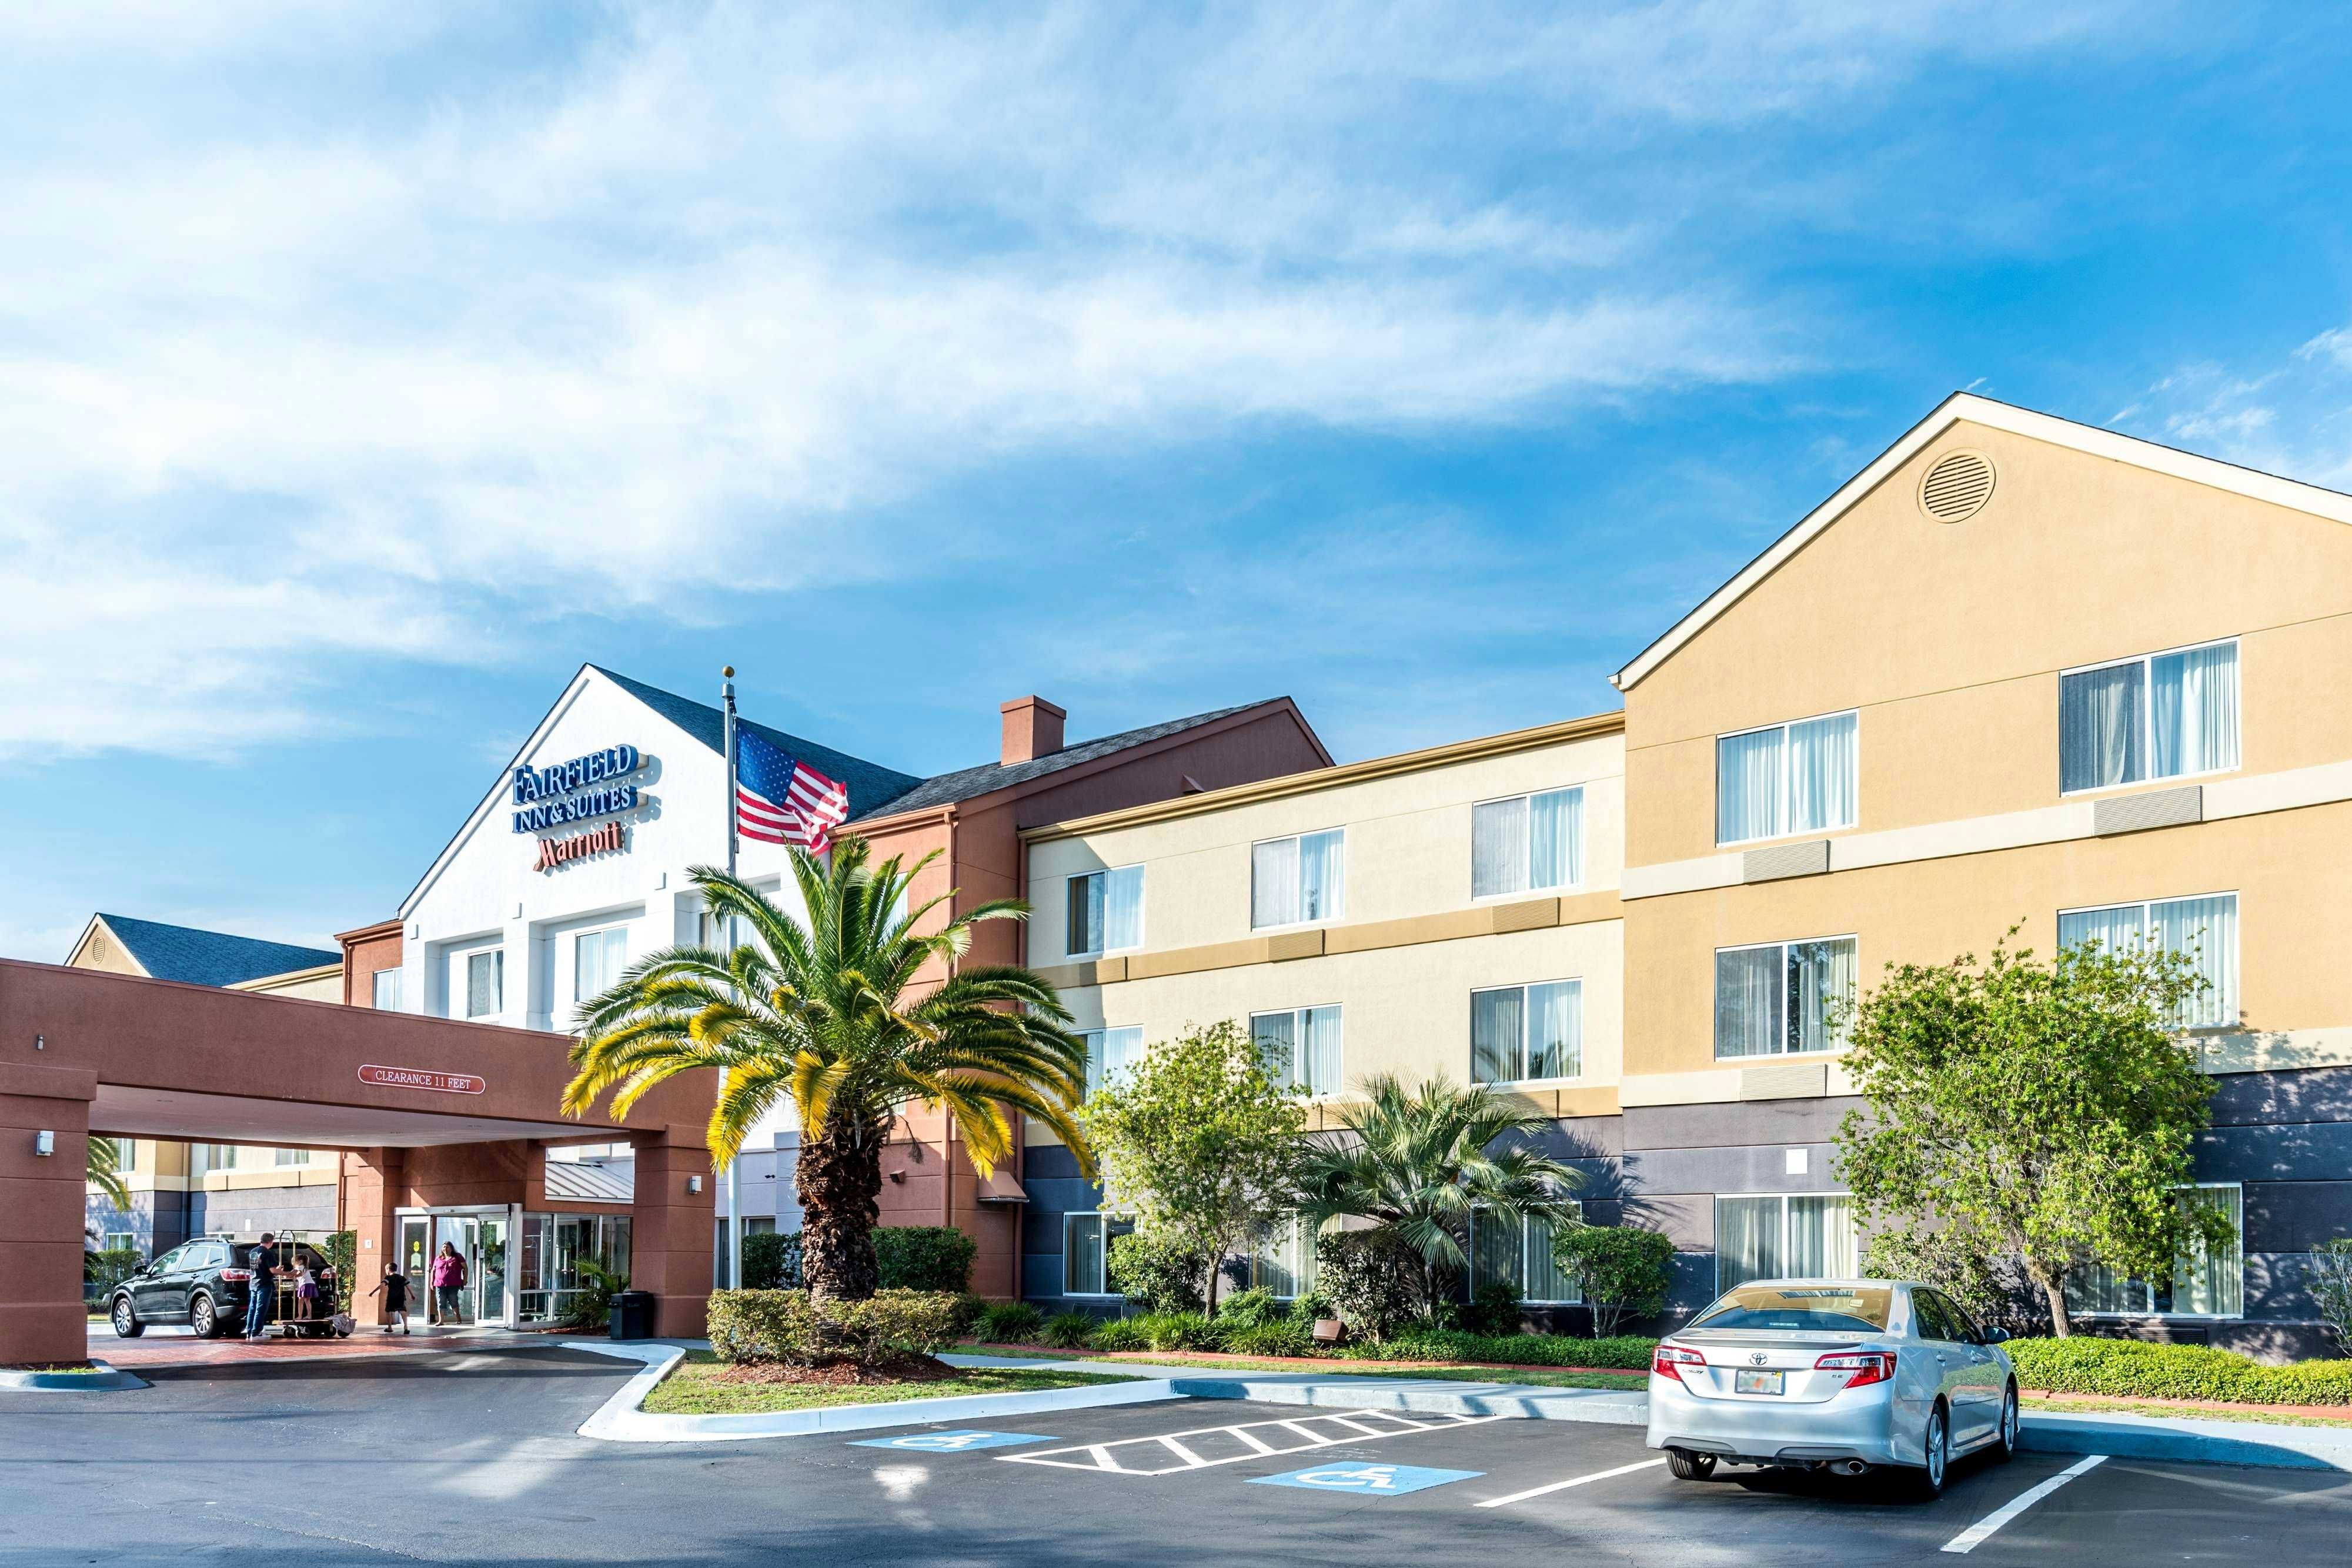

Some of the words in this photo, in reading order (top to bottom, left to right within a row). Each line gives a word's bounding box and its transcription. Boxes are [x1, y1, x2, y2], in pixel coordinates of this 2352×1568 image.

[511, 744, 633, 805] FAIRFIELD
[533, 821, 619, 871] Marriott
[375, 1070, 432, 1085] CLEARANCE
[435, 1076, 445, 1086] 11
[447, 1078, 471, 1089] FEET
